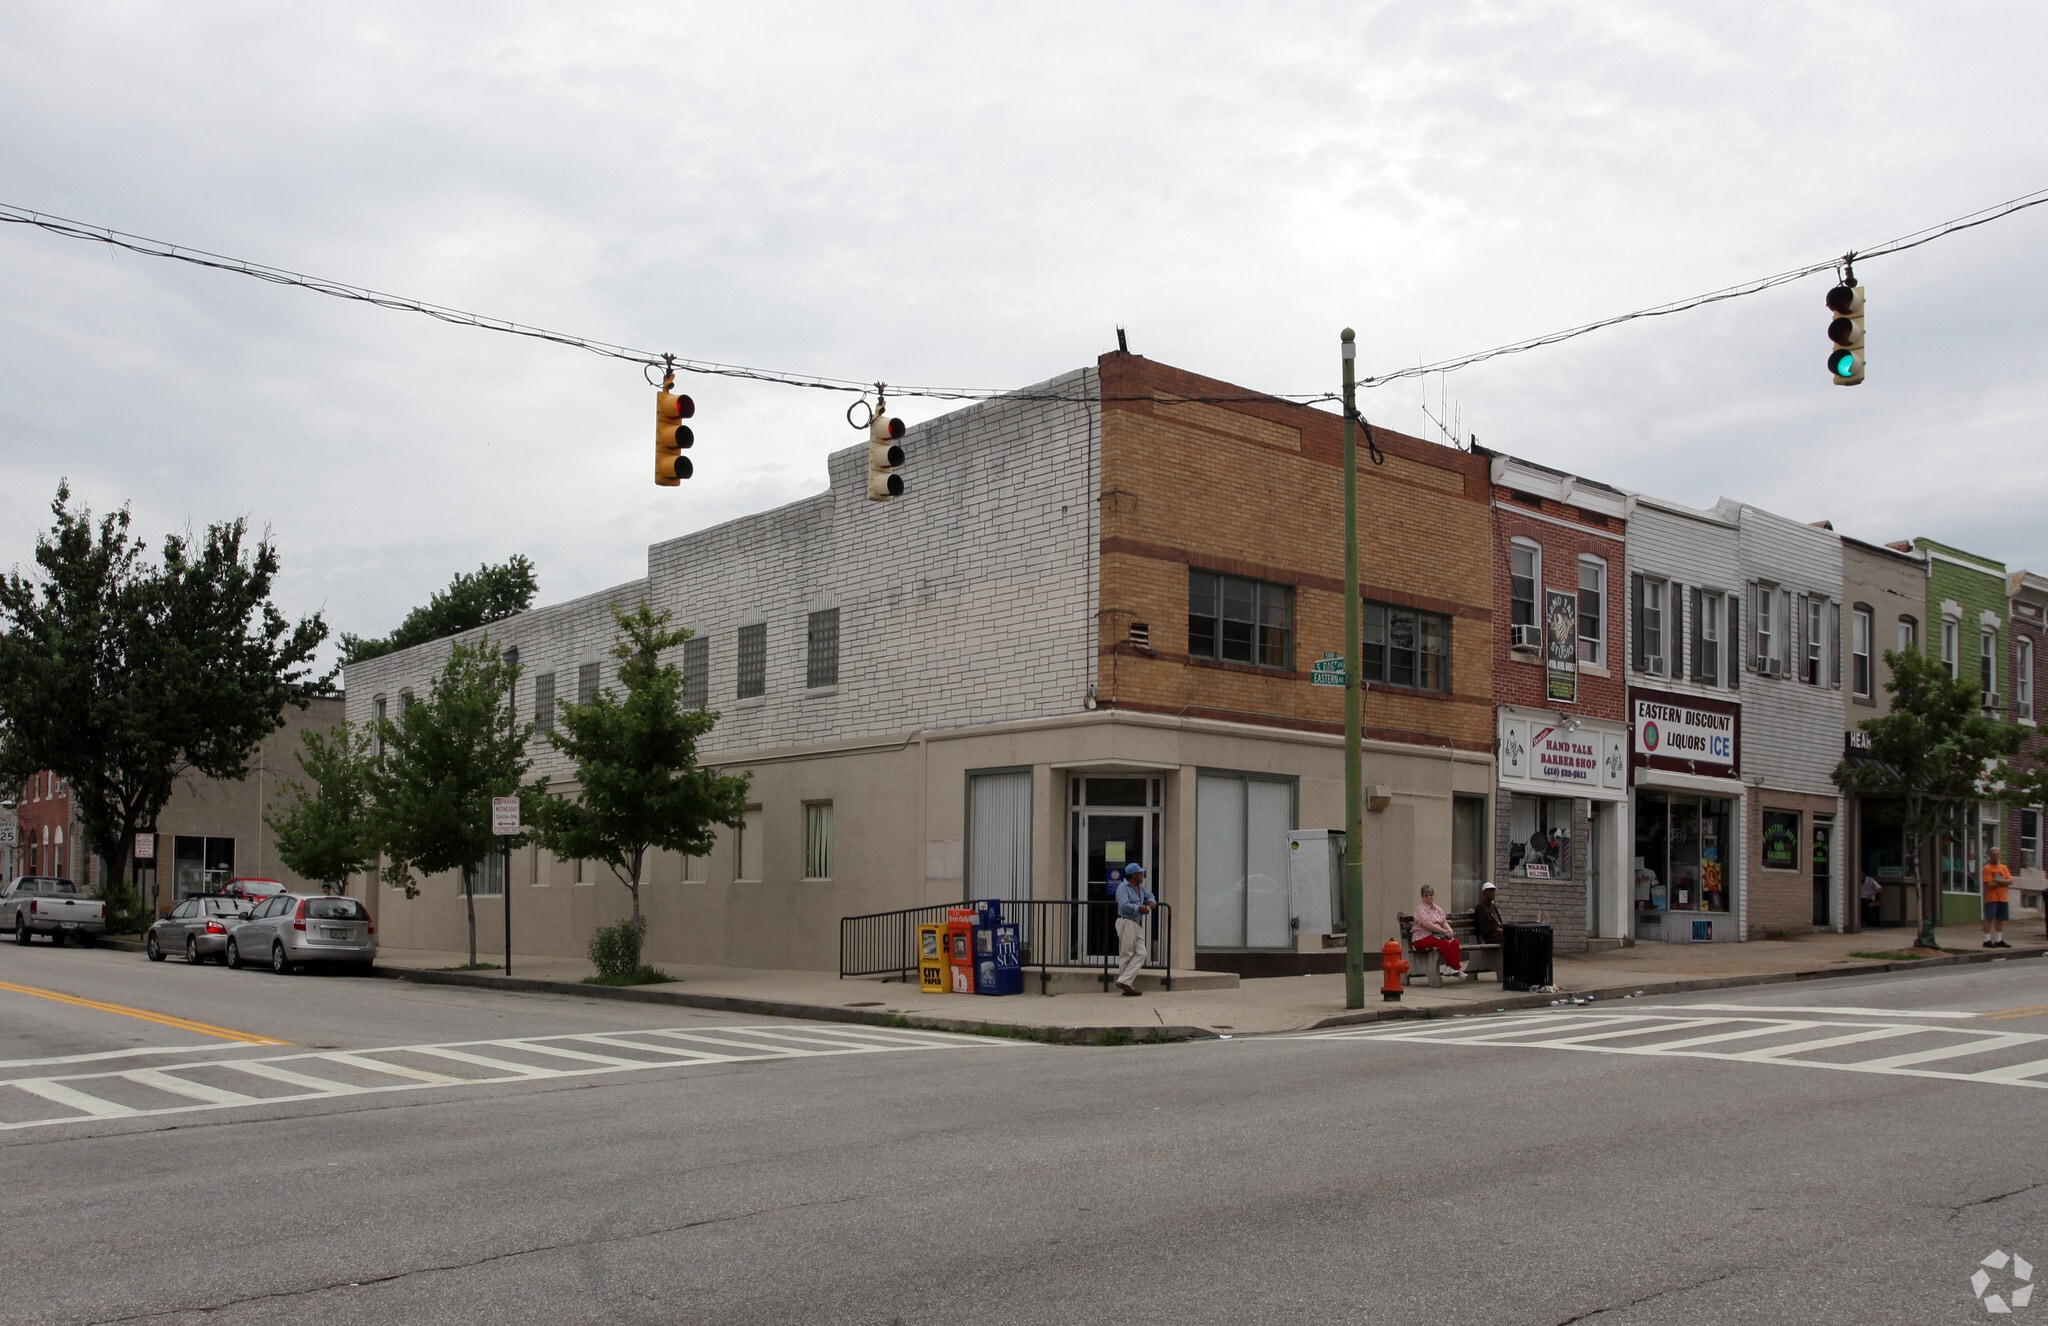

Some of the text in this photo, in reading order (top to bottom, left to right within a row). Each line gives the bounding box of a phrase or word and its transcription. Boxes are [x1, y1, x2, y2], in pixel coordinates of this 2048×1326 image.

[1547, 596, 1575, 624] HAND TALK
[1551, 642, 1574, 659] STUDIO
[1314, 673, 1338, 684] EASTERN
[1639, 702, 1730, 731] EASTERN DISCOUNT
[1546, 740, 1593, 755] HAND TALK
[1667, 732, 1730, 757] LIQUORS ICE
[1541, 753, 1597, 769] BARBER SHOP
[1543, 765, 1560, 777] (410)
[1, 832, 14, 841] 25
[996, 942, 1019, 954] THE
[997, 953, 1019, 967] SUN
[923, 967, 941, 978] CITY
[951, 965, 968, 992] b
